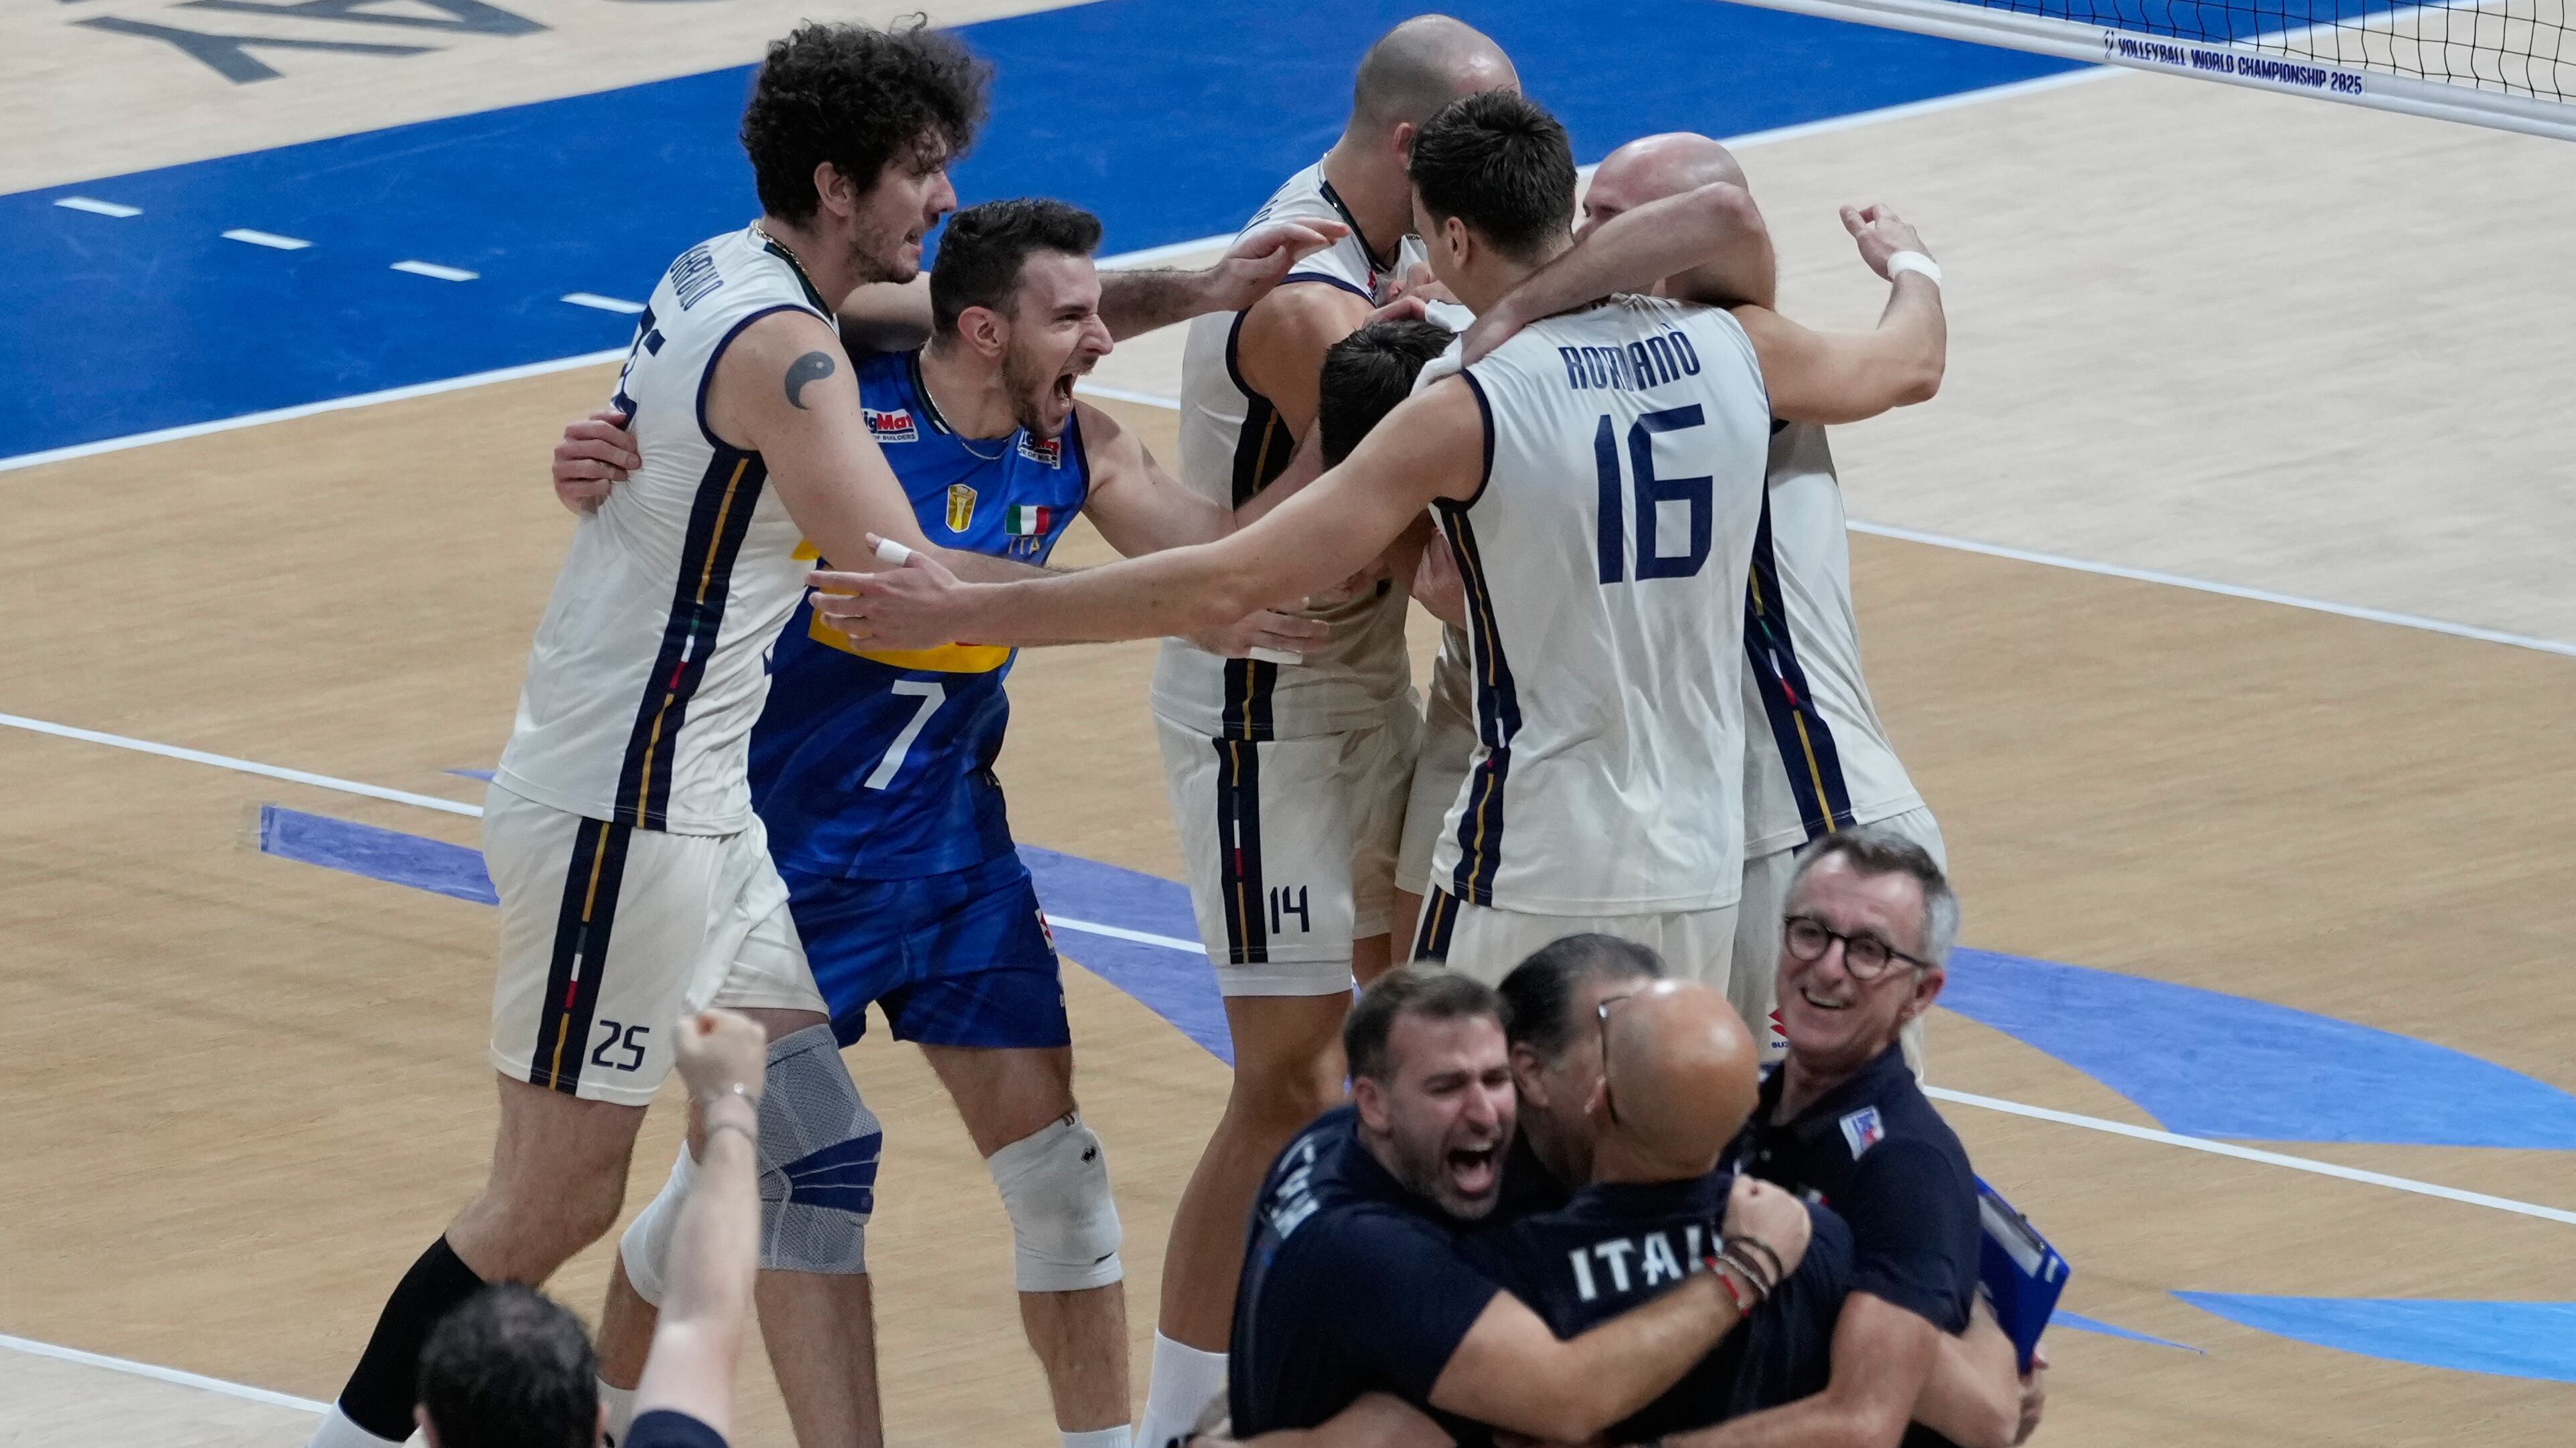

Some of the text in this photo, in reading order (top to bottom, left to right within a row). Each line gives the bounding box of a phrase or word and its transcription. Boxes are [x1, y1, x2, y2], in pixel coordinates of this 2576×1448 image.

[67, 0, 556, 84] AY
[2118, 37, 2363, 95] VOLLEYBALL WORLD CHAMPIONSHIP 2025
[1558, 323, 1701, 392] ROMANÒ
[862, 411, 913, 433] igMat
[1594, 403, 1714, 585] 16
[1007, 536, 1041, 555] ITA
[864, 679, 947, 791] 7
[1270, 885, 1310, 935] 14
[591, 1020, 650, 1072] 25
